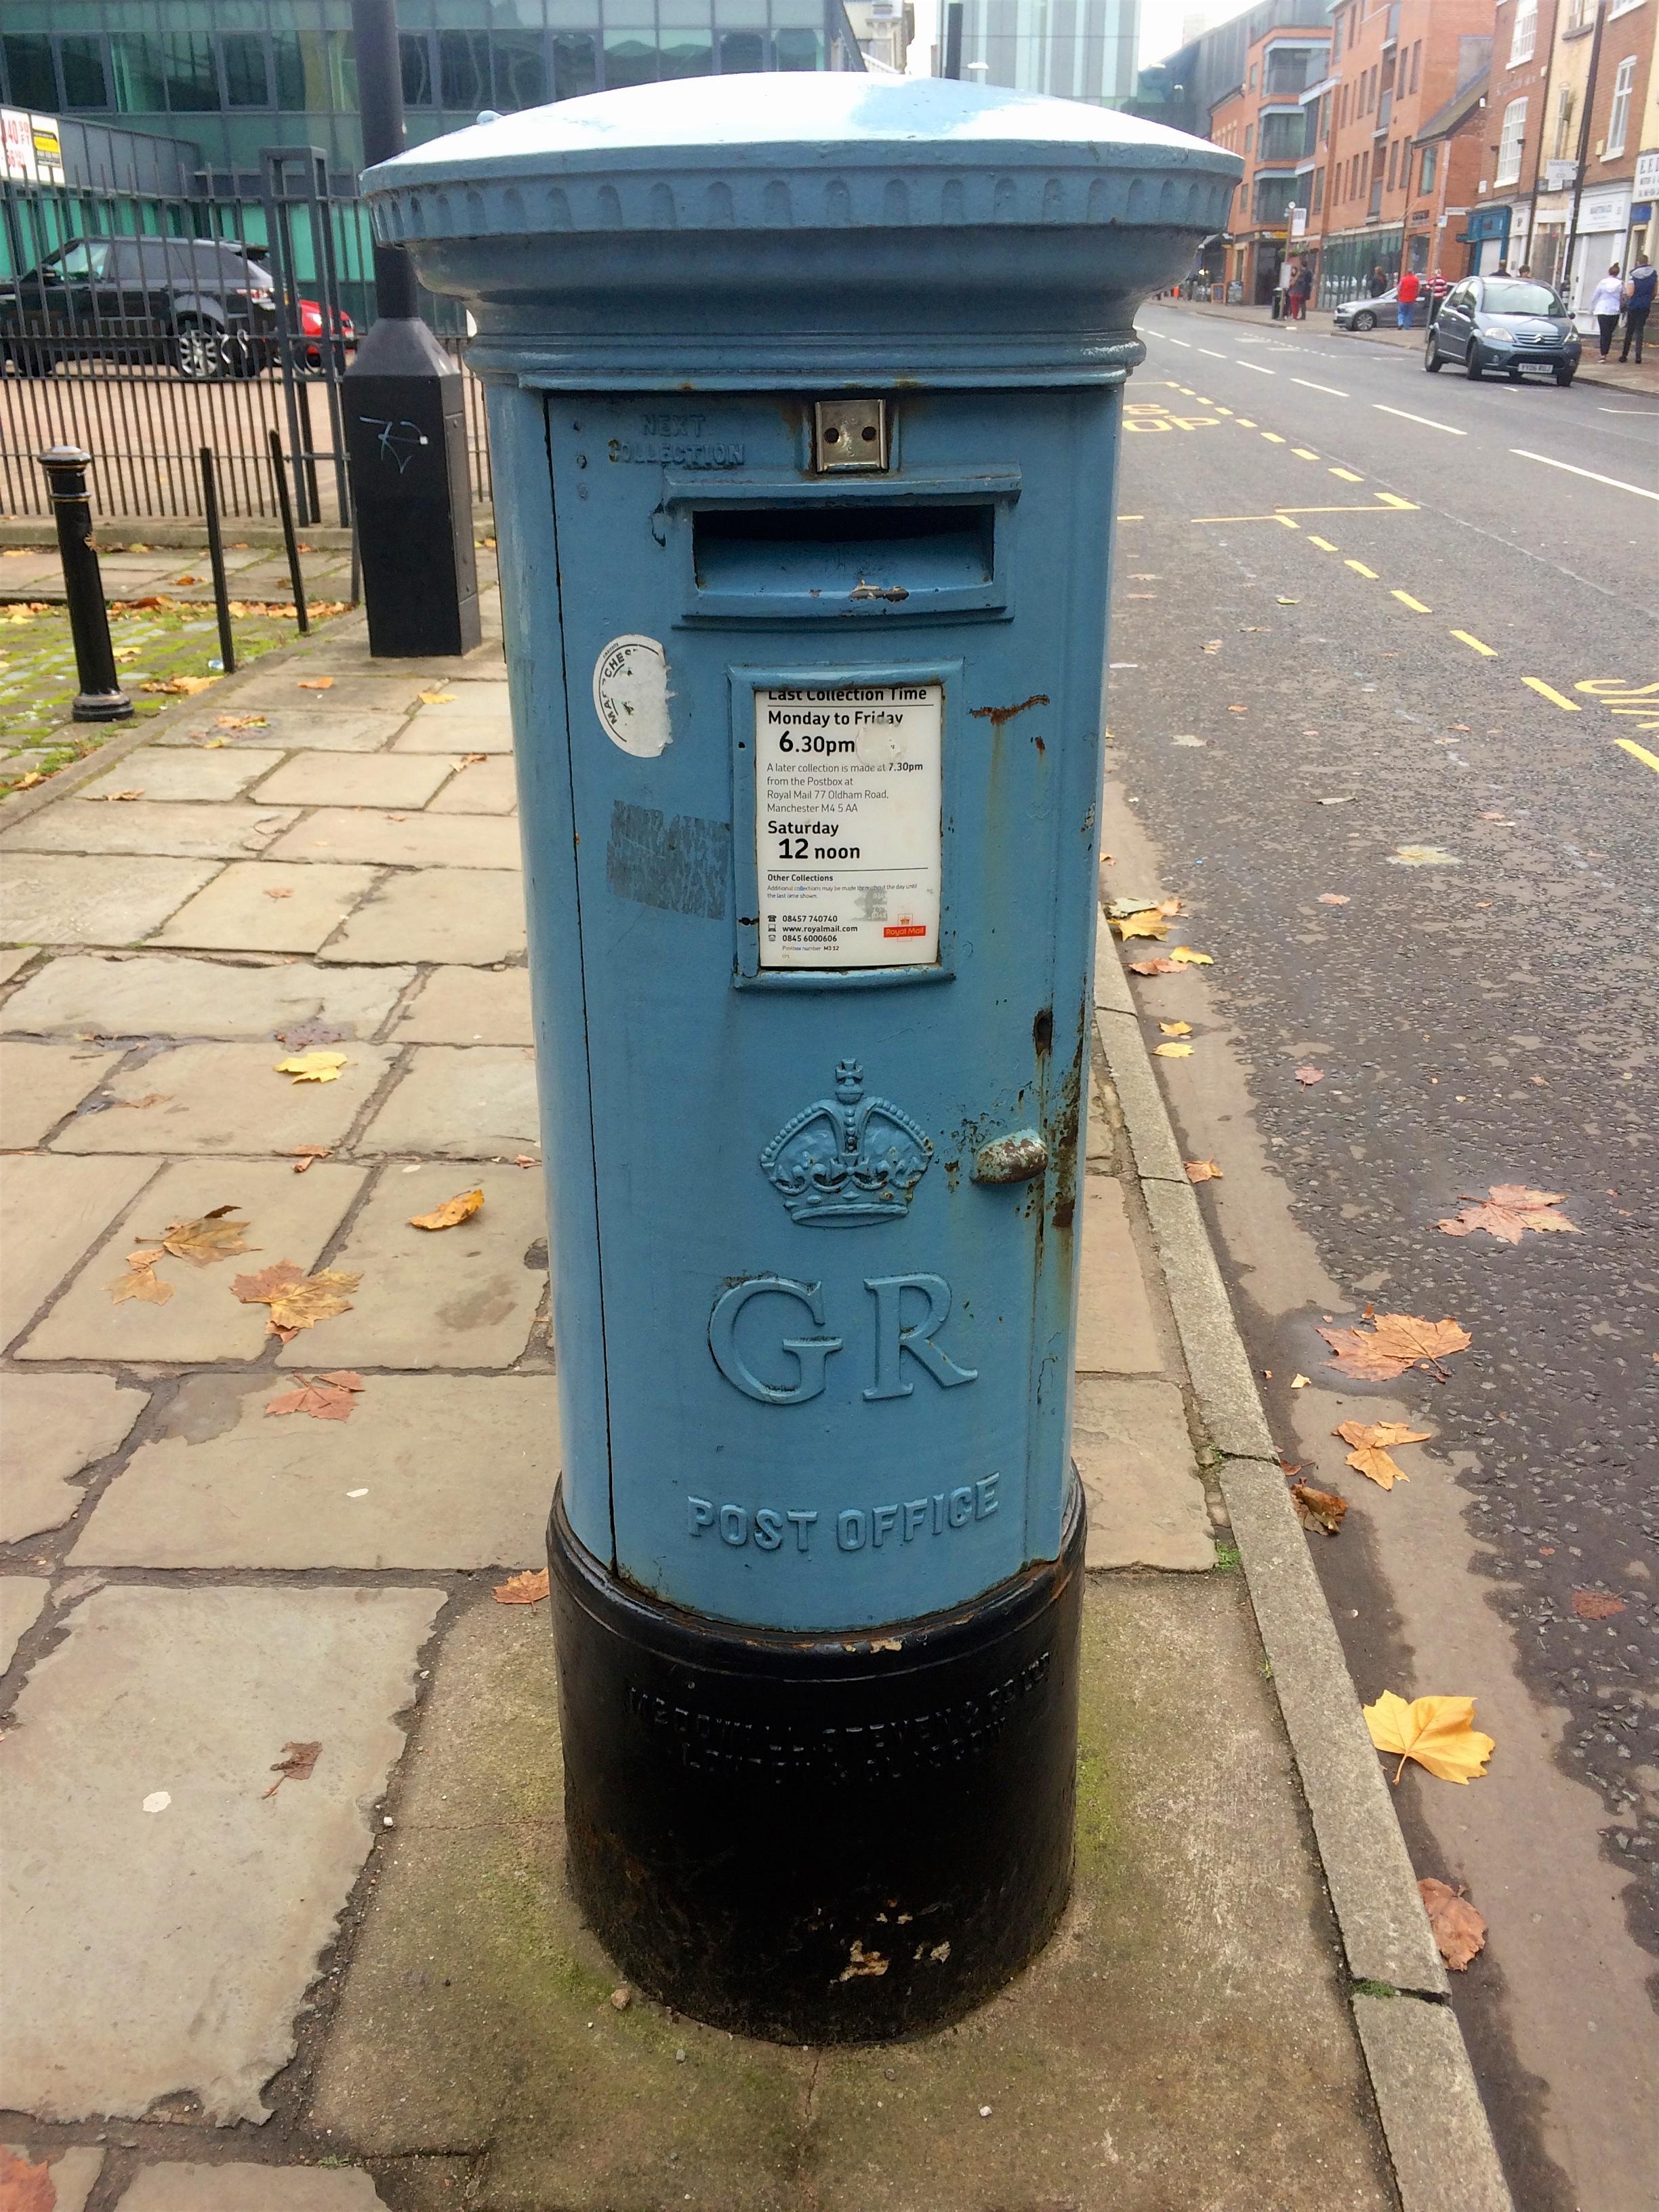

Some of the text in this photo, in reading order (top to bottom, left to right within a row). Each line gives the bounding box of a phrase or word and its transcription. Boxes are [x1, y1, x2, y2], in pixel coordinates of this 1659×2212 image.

[642, 413, 705, 438] NEXT
[768, 688, 927, 701] Last Collection Time
[769, 710, 903, 729] Monday to Friday
[779, 730, 855, 757] 6.30pm
[766, 762, 774, 772] A
[775, 762, 796, 773] later
[798, 763, 840, 773] collection
[851, 764, 876, 773] made
[877, 764, 886, 772] at
[888, 762, 923, 773] 7.30pm
[766, 776, 853, 786] from the Postbox at
[767, 790, 792, 801] Royal
[794, 790, 812, 799] Mail
[814, 790, 826, 799] 77
[828, 790, 863, 800] Oldham
[767, 802, 858, 813] Manchester M4 5 AA
[768, 820, 839, 838] Saturday
[778, 838, 860, 859] 12 noon
[767, 874, 834, 882] Other Collections
[782, 925, 858, 934] www.royalmail.com
[886, 926, 924, 937] Royal Mail
[803, 935, 838, 943] 6000606
[708, 1271, 978, 1404] GR
[687, 1471, 1000, 1552] POST OFFICE
